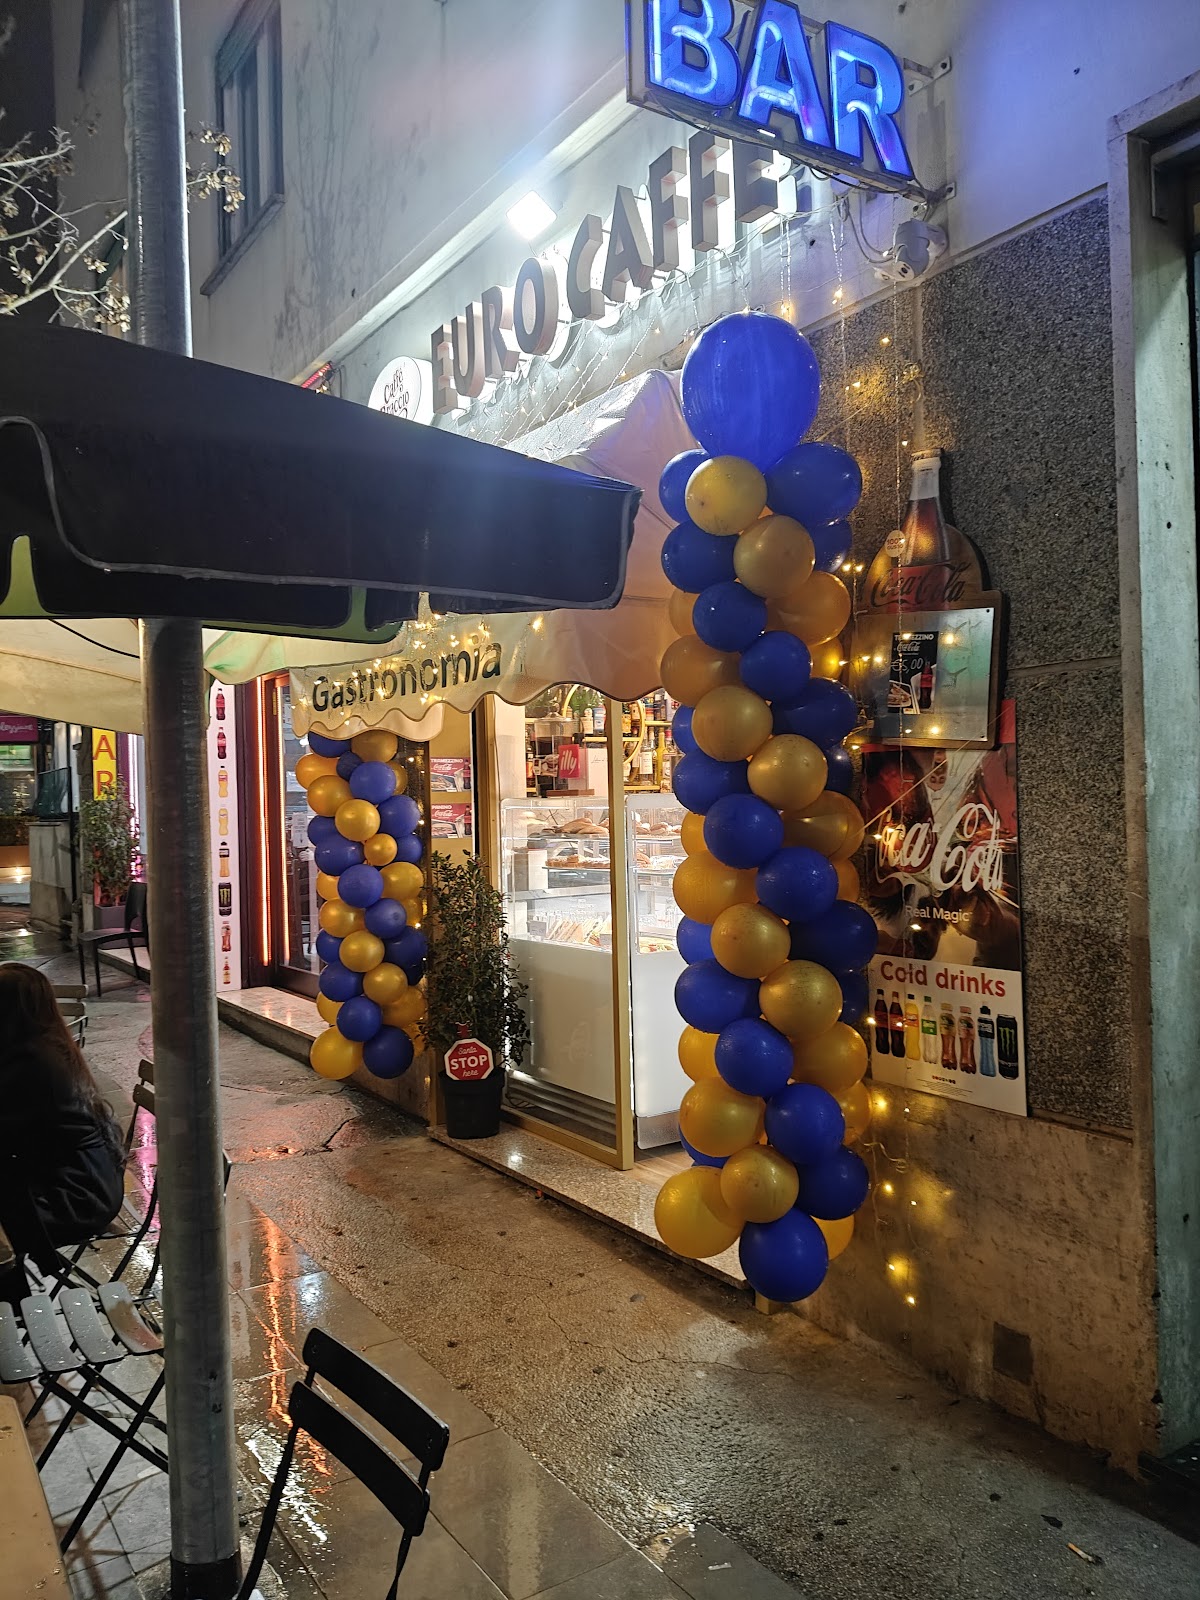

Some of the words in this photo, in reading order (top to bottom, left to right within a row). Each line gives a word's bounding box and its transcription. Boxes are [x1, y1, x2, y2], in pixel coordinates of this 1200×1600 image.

[645, 0, 915, 181] BAR
[431, 257, 559, 414] EURO
[312, 634, 502, 712] Gastronomia
[560, 750, 577, 774] illy
[905, 905, 930, 918] Real
[932, 907, 970, 923] Magic
[880, 960, 928, 987] Cold
[936, 967, 1007, 998] drinks
[450, 1054, 488, 1070] STOP
[458, 1046, 478, 1055] Santa
[462, 1069, 479, 1077] here
